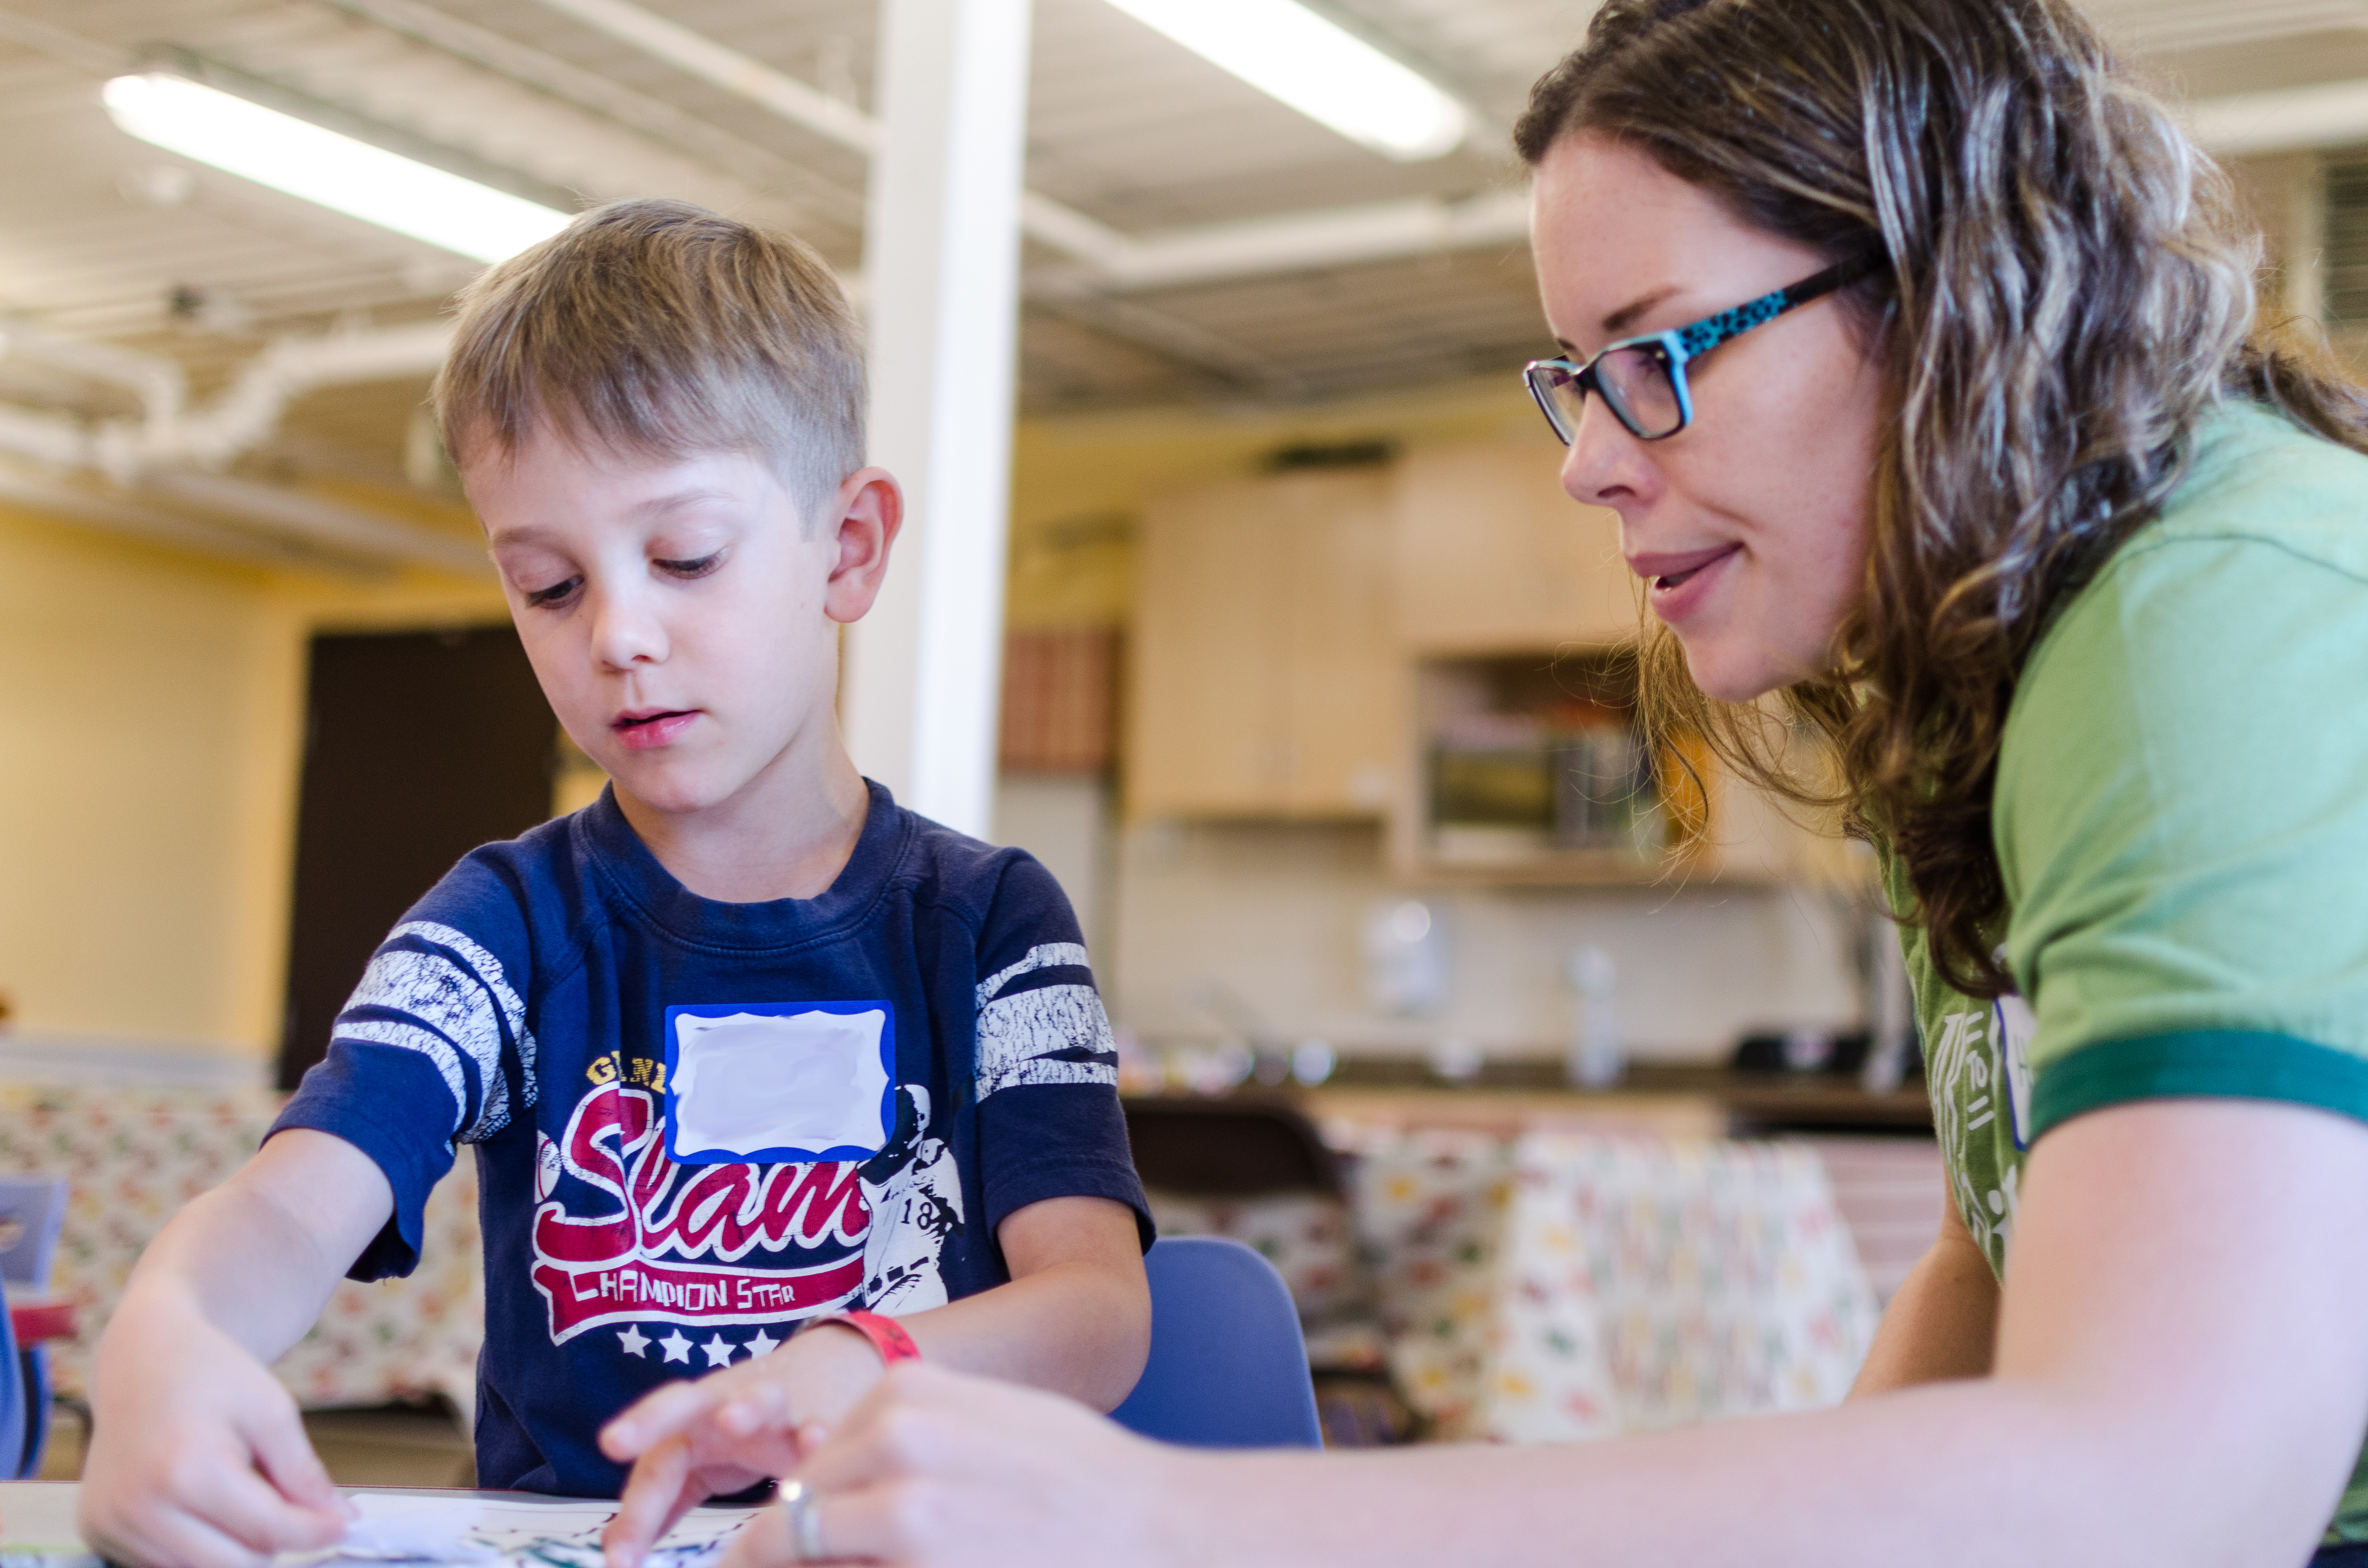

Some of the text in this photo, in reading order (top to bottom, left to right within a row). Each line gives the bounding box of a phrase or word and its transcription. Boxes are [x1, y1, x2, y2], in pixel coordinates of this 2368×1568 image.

[532, 1081, 871, 1263] Slam
[901, 1198, 933, 1230] 18
[737, 1278, 796, 1309] STAR
